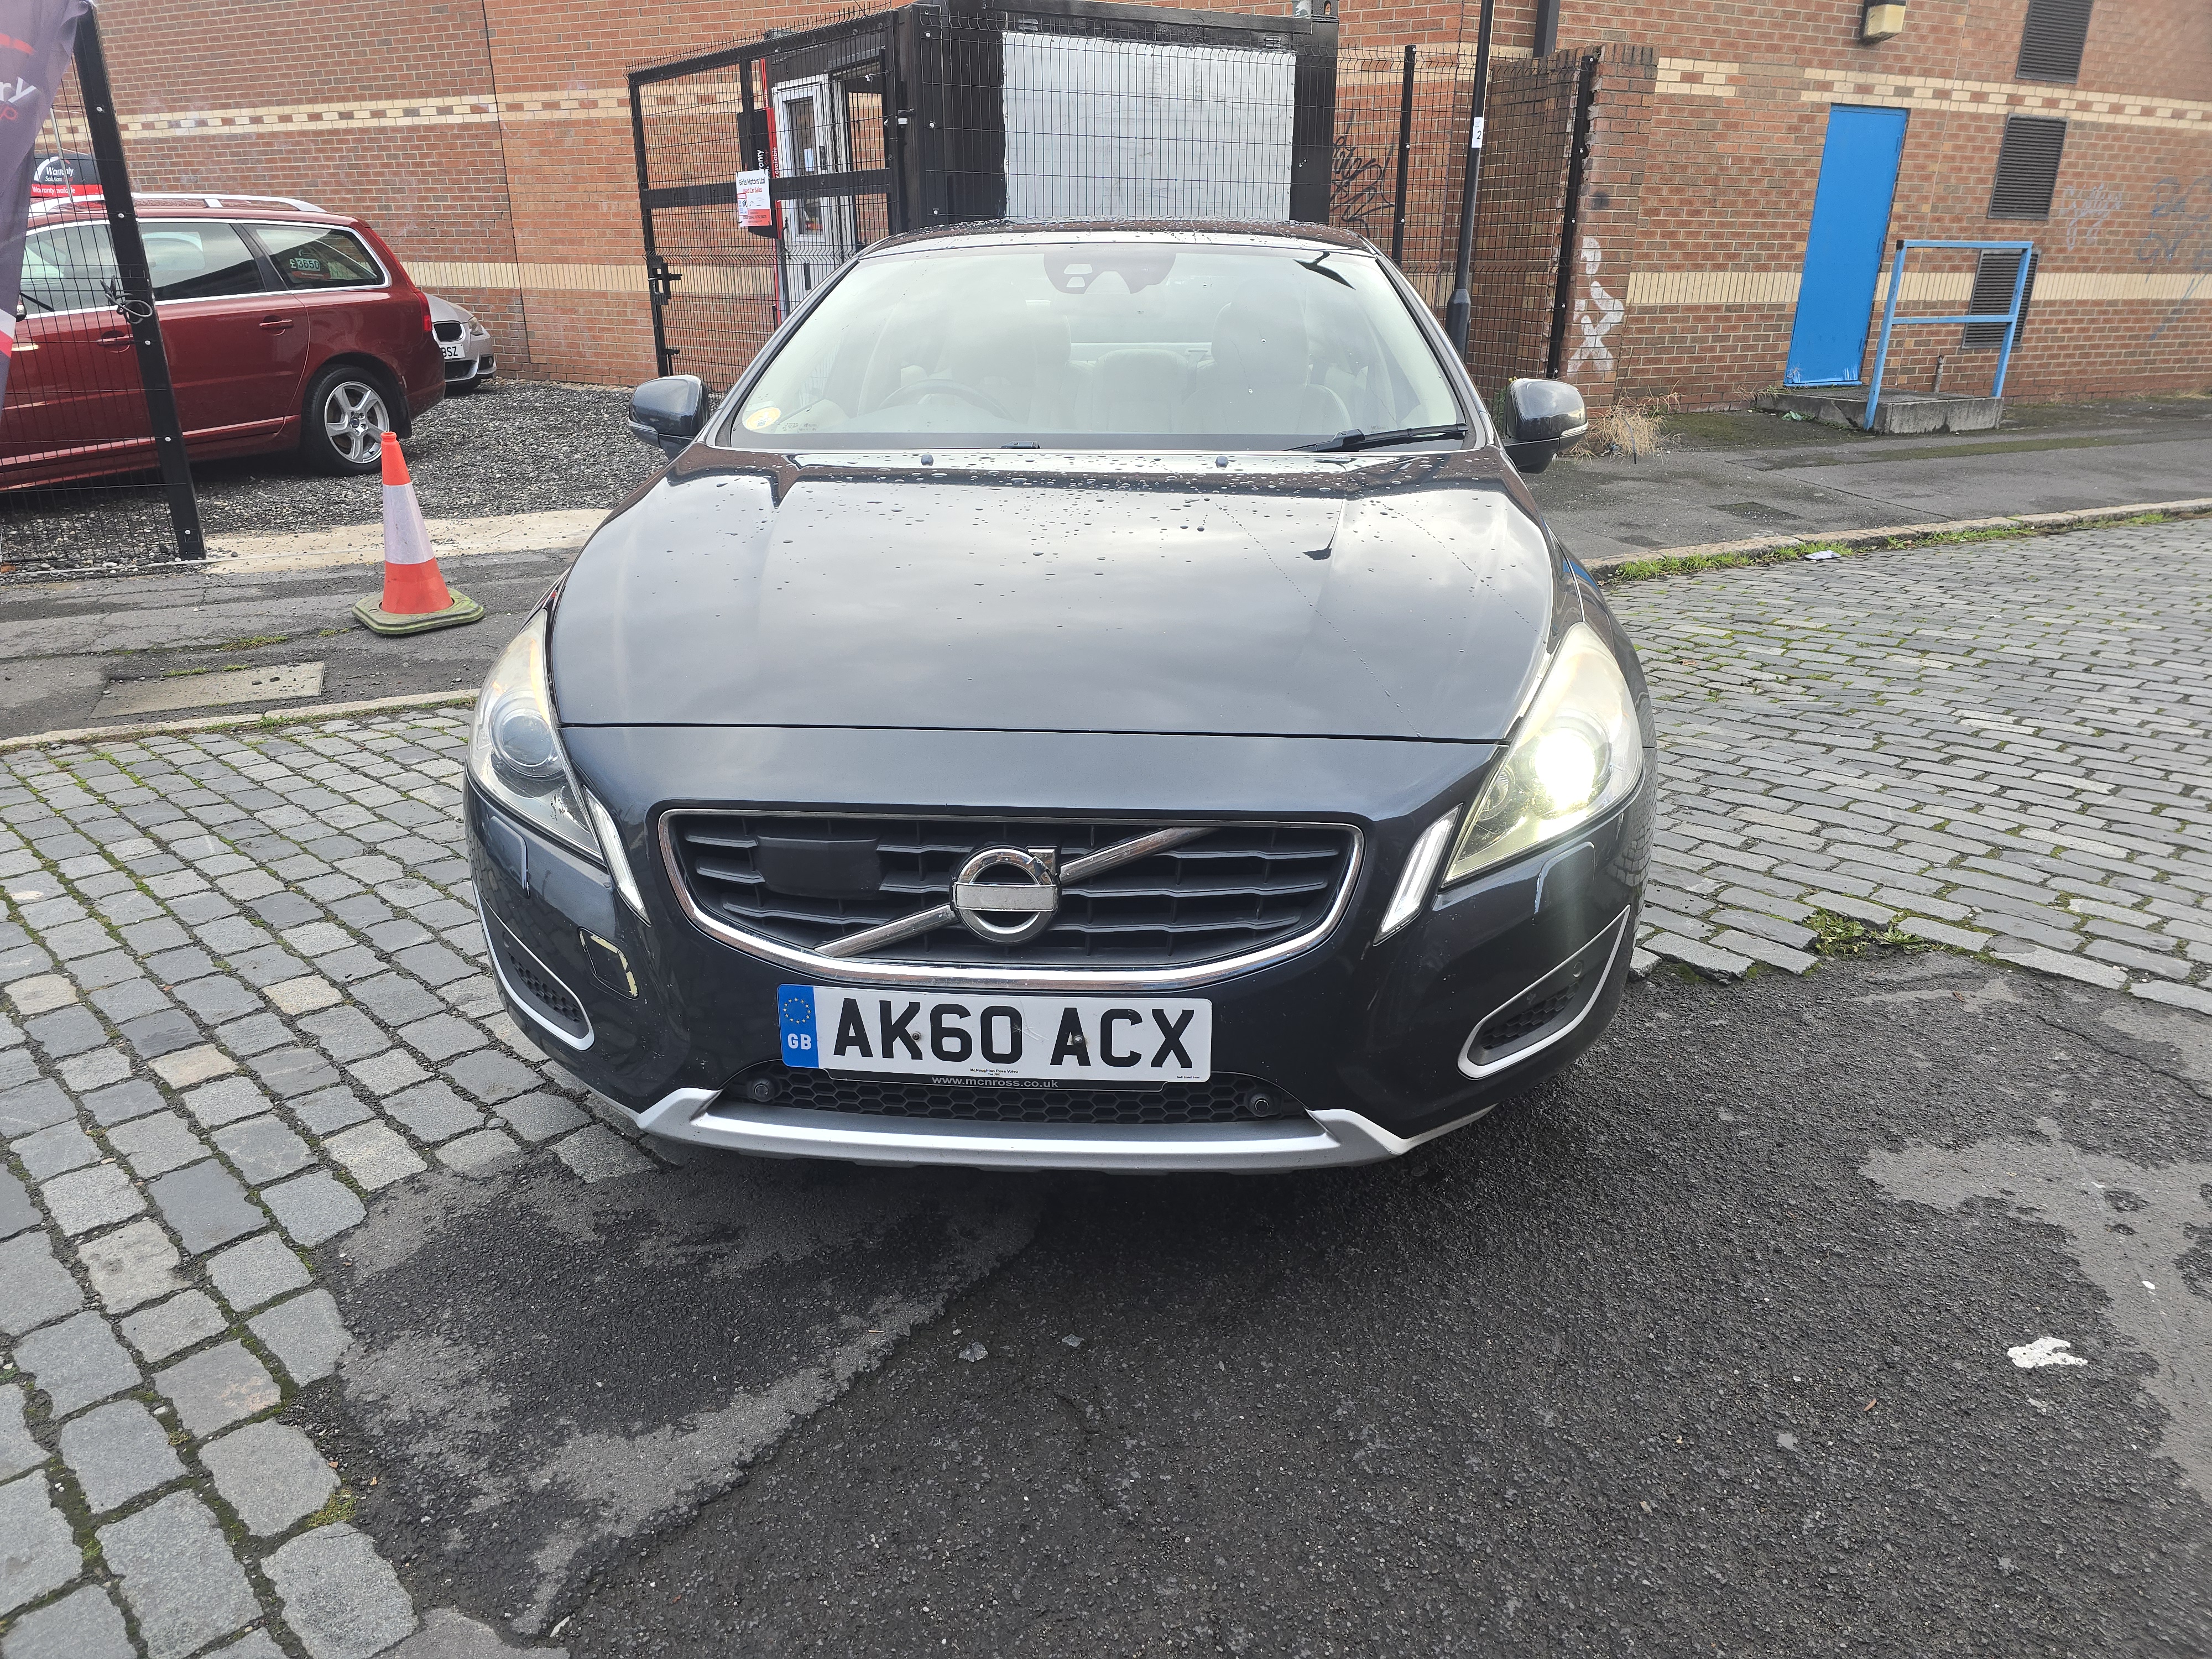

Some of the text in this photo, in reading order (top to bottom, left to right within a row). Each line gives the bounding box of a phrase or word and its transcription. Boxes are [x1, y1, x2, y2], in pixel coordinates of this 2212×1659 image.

[1476, 130, 1481, 140] 2
[833, 998, 1194, 1068] AK60 ACX
[787, 1033, 812, 1050] GB
[931, 1076, 1058, 1088] www.mcnross.co.uk
